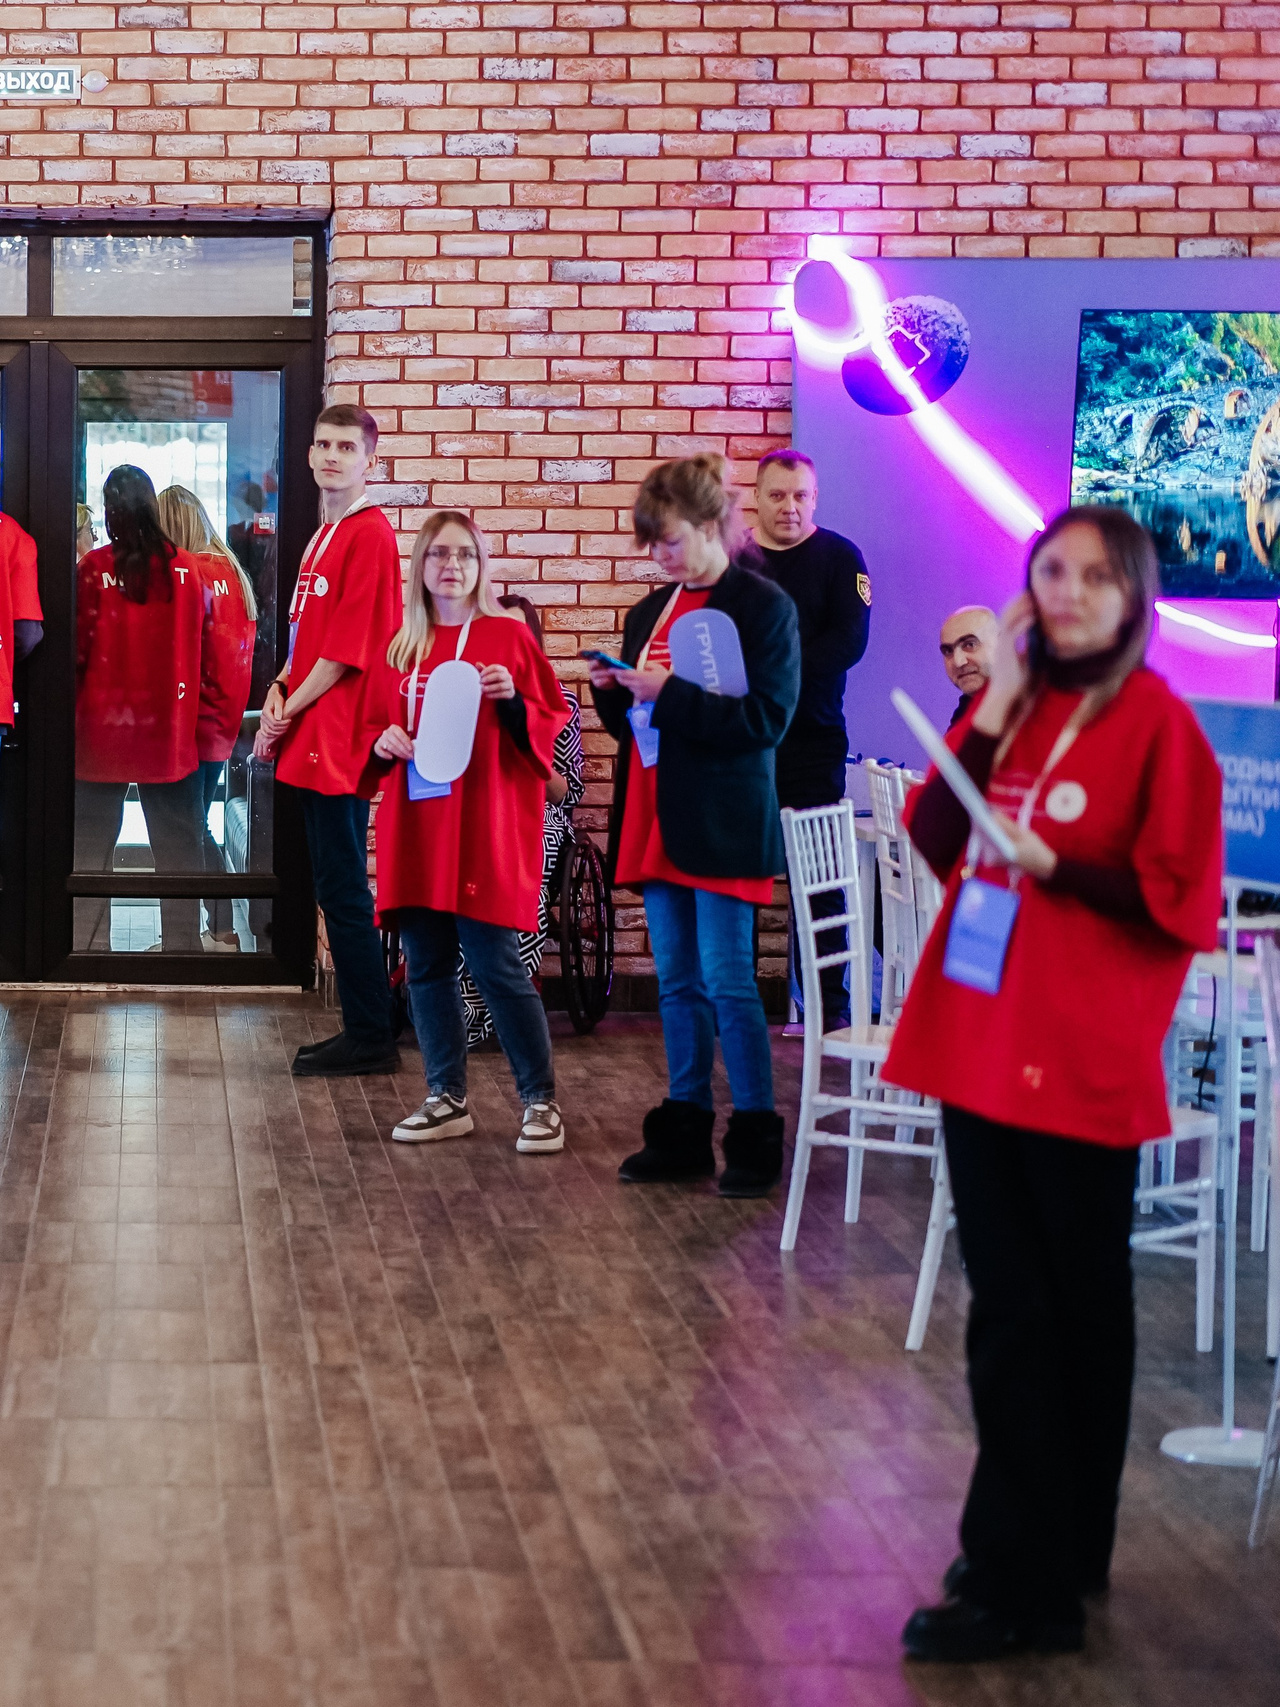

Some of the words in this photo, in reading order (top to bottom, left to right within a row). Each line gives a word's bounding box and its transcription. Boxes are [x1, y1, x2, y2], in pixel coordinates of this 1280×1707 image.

[174, 567, 189, 585] Т
[213, 579, 229, 597] М
[694, 622, 721, 696] ГРУПП
[178, 682, 186, 700] С
